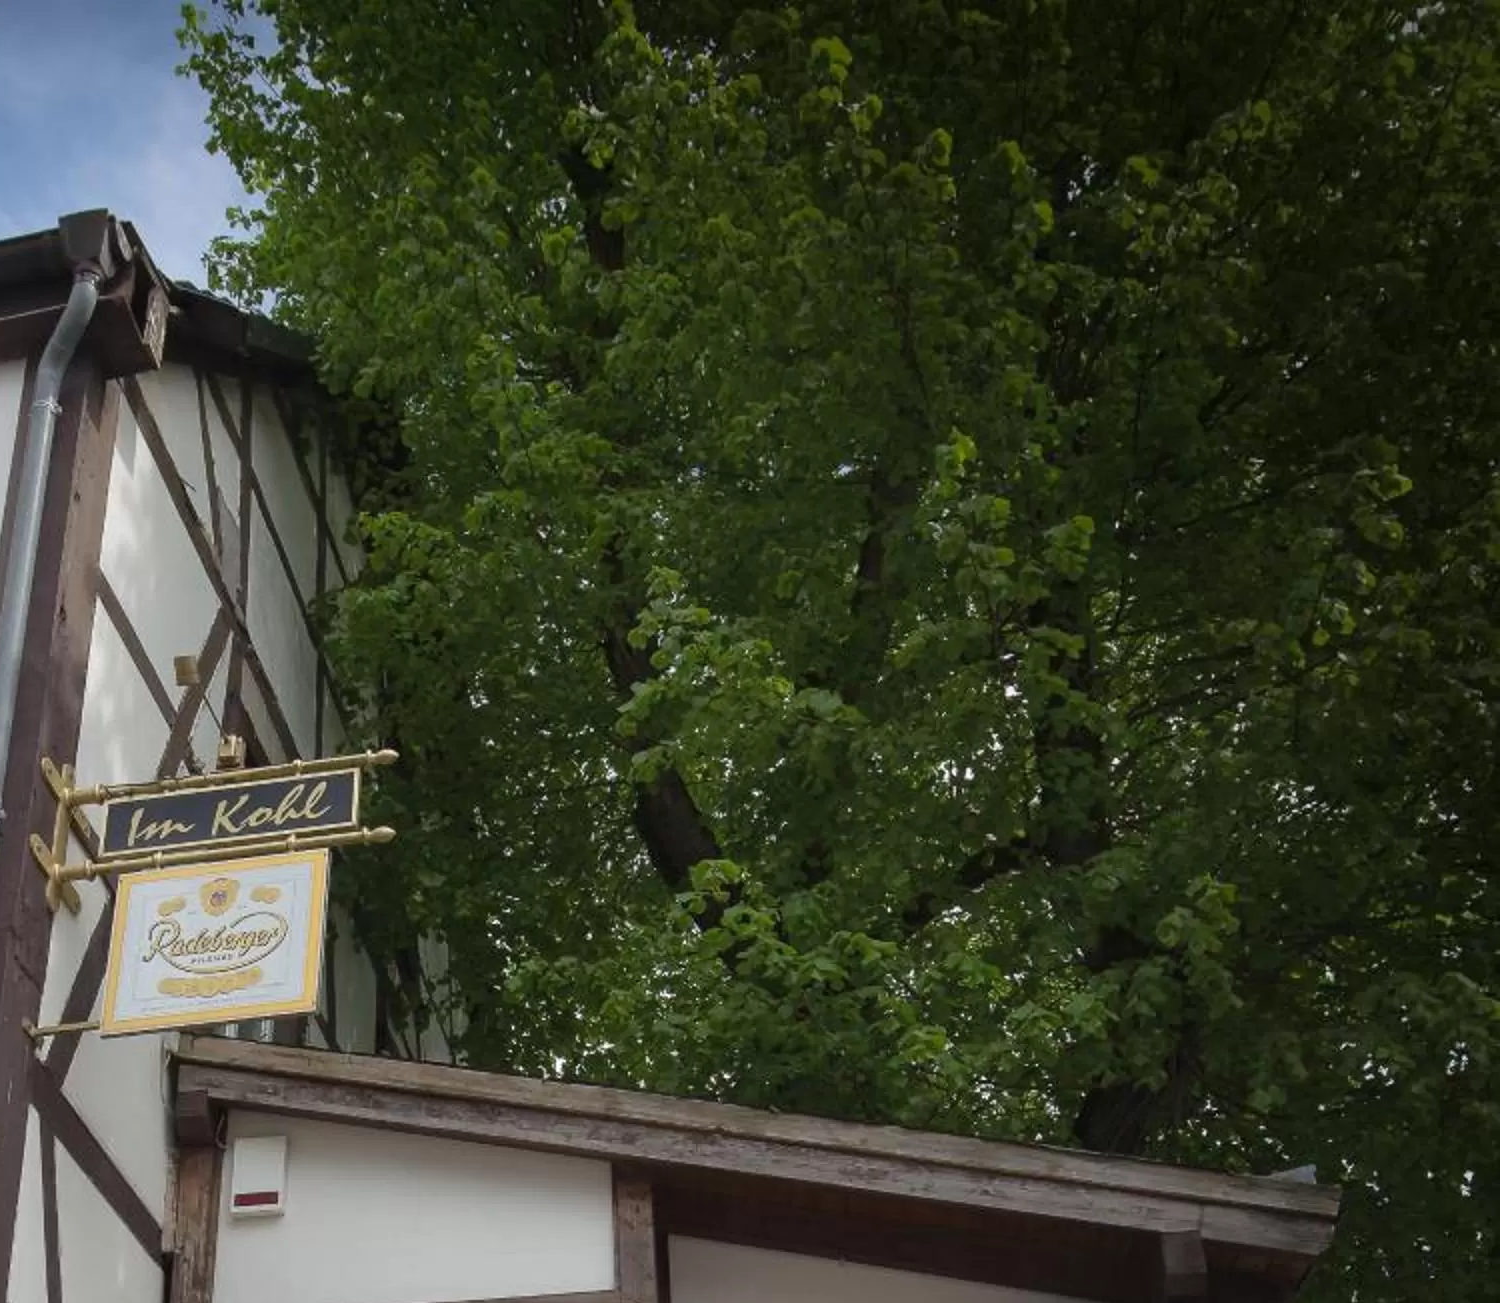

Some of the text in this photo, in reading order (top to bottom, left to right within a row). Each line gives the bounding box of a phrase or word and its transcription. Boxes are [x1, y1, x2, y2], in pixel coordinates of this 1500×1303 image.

[126, 780, 332, 847] Im Kohl
[142, 918, 281, 963] Radeberger
